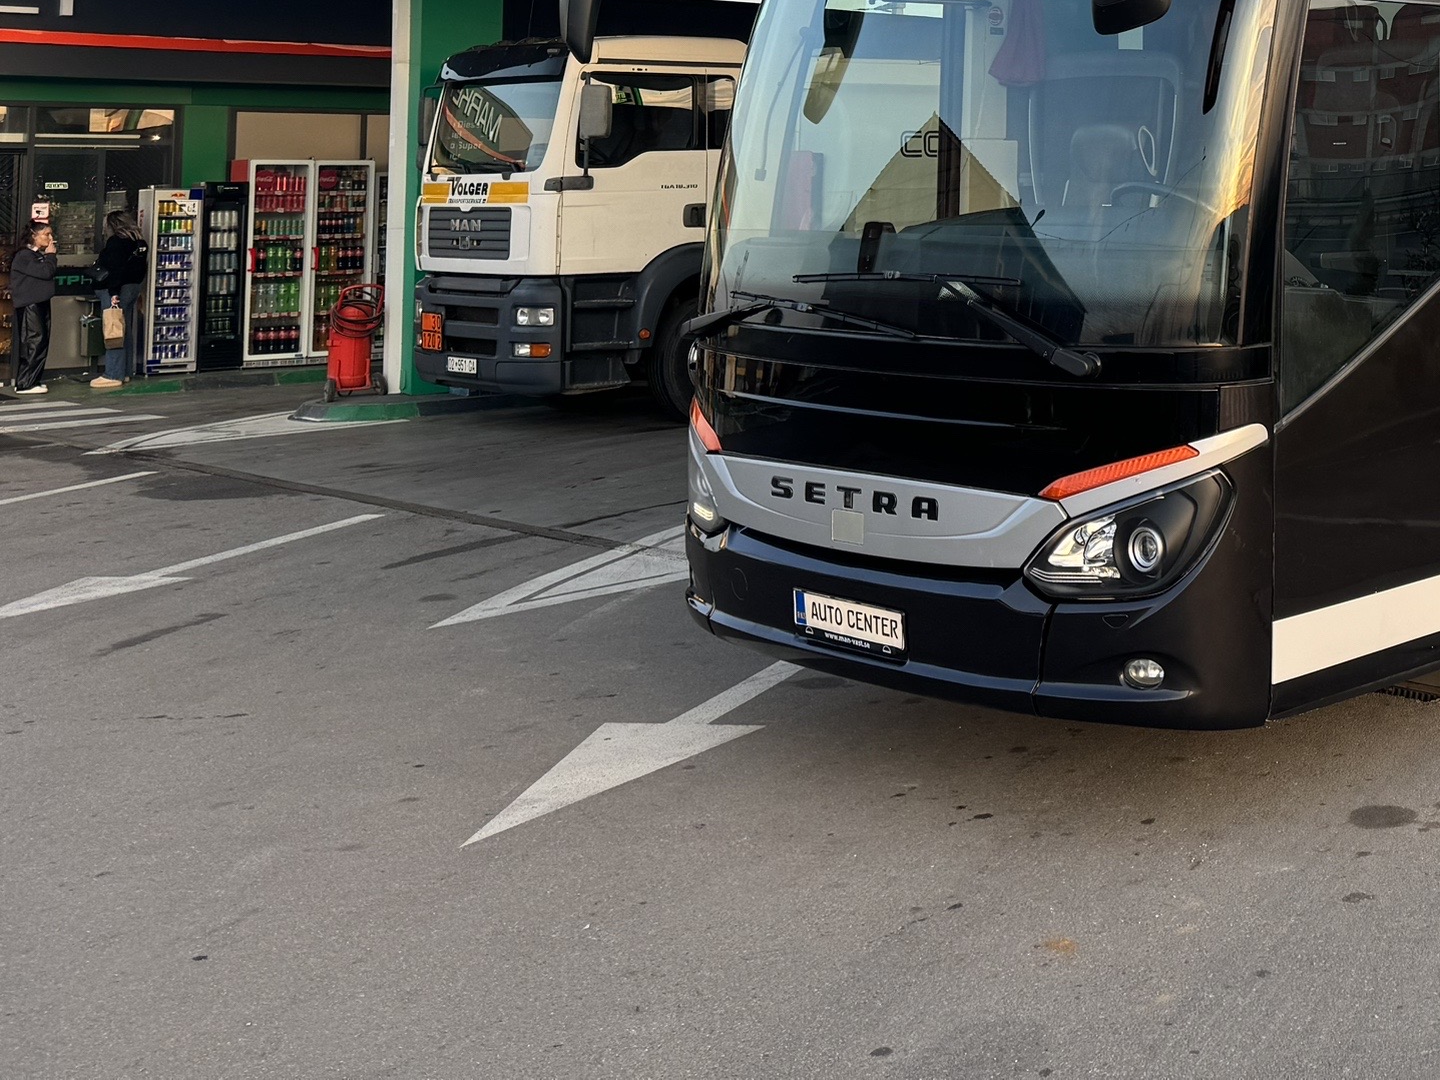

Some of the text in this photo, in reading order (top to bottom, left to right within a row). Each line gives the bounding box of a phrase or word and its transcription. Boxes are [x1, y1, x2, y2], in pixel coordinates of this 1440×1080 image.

[447, 176, 489, 197] VOLGER
[450, 219, 482, 232] MAN
[431, 315, 441, 330] 30
[423, 333, 442, 350] 1202
[770, 475, 939, 522] SETRA
[811, 601, 899, 640] AUTO CENTER
